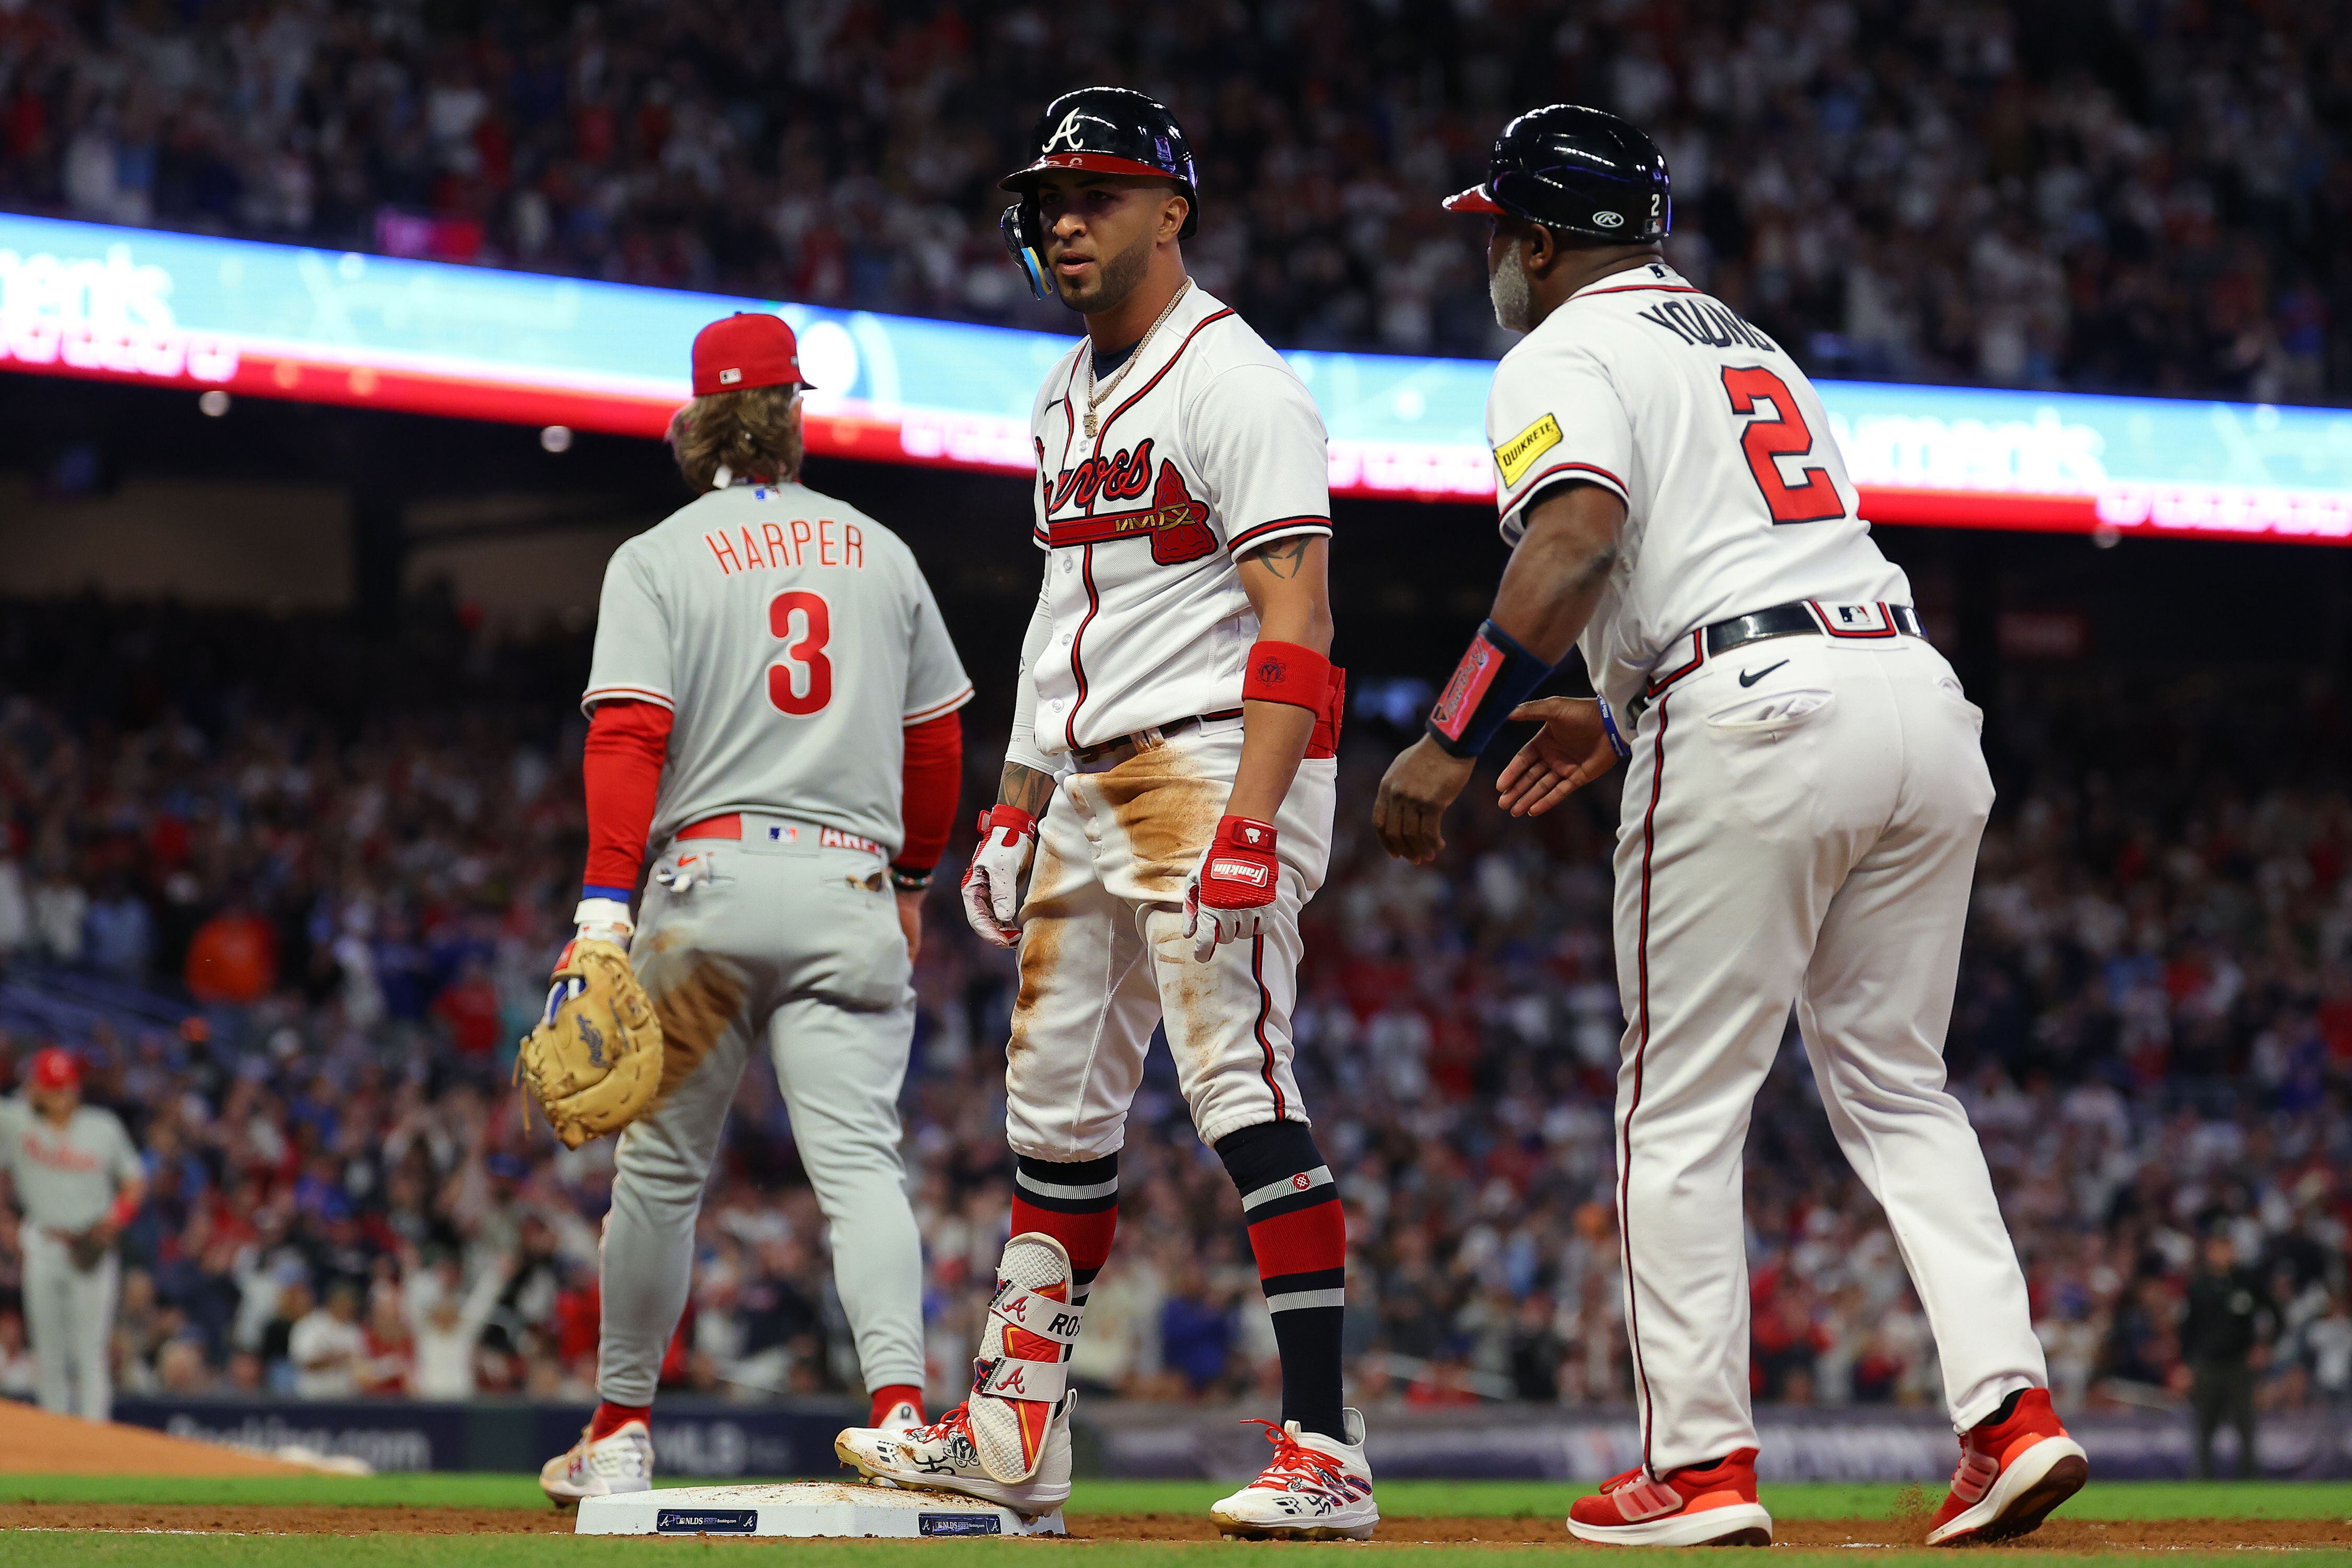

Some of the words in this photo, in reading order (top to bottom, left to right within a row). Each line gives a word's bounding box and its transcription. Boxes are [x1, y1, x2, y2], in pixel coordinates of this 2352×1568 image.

[1042, 107, 1083, 153] A
[1651, 193, 1661, 217] 2
[0, 244, 176, 330] ents
[1636, 298, 1776, 352] YOUNG
[1502, 421, 1553, 467] QUIKRETE
[1721, 364, 1847, 525] 2
[702, 517, 864, 575] HARPER
[765, 586, 833, 719] 3
[1001, 1296, 1029, 1323] A
[995, 1365, 1025, 1394] A
